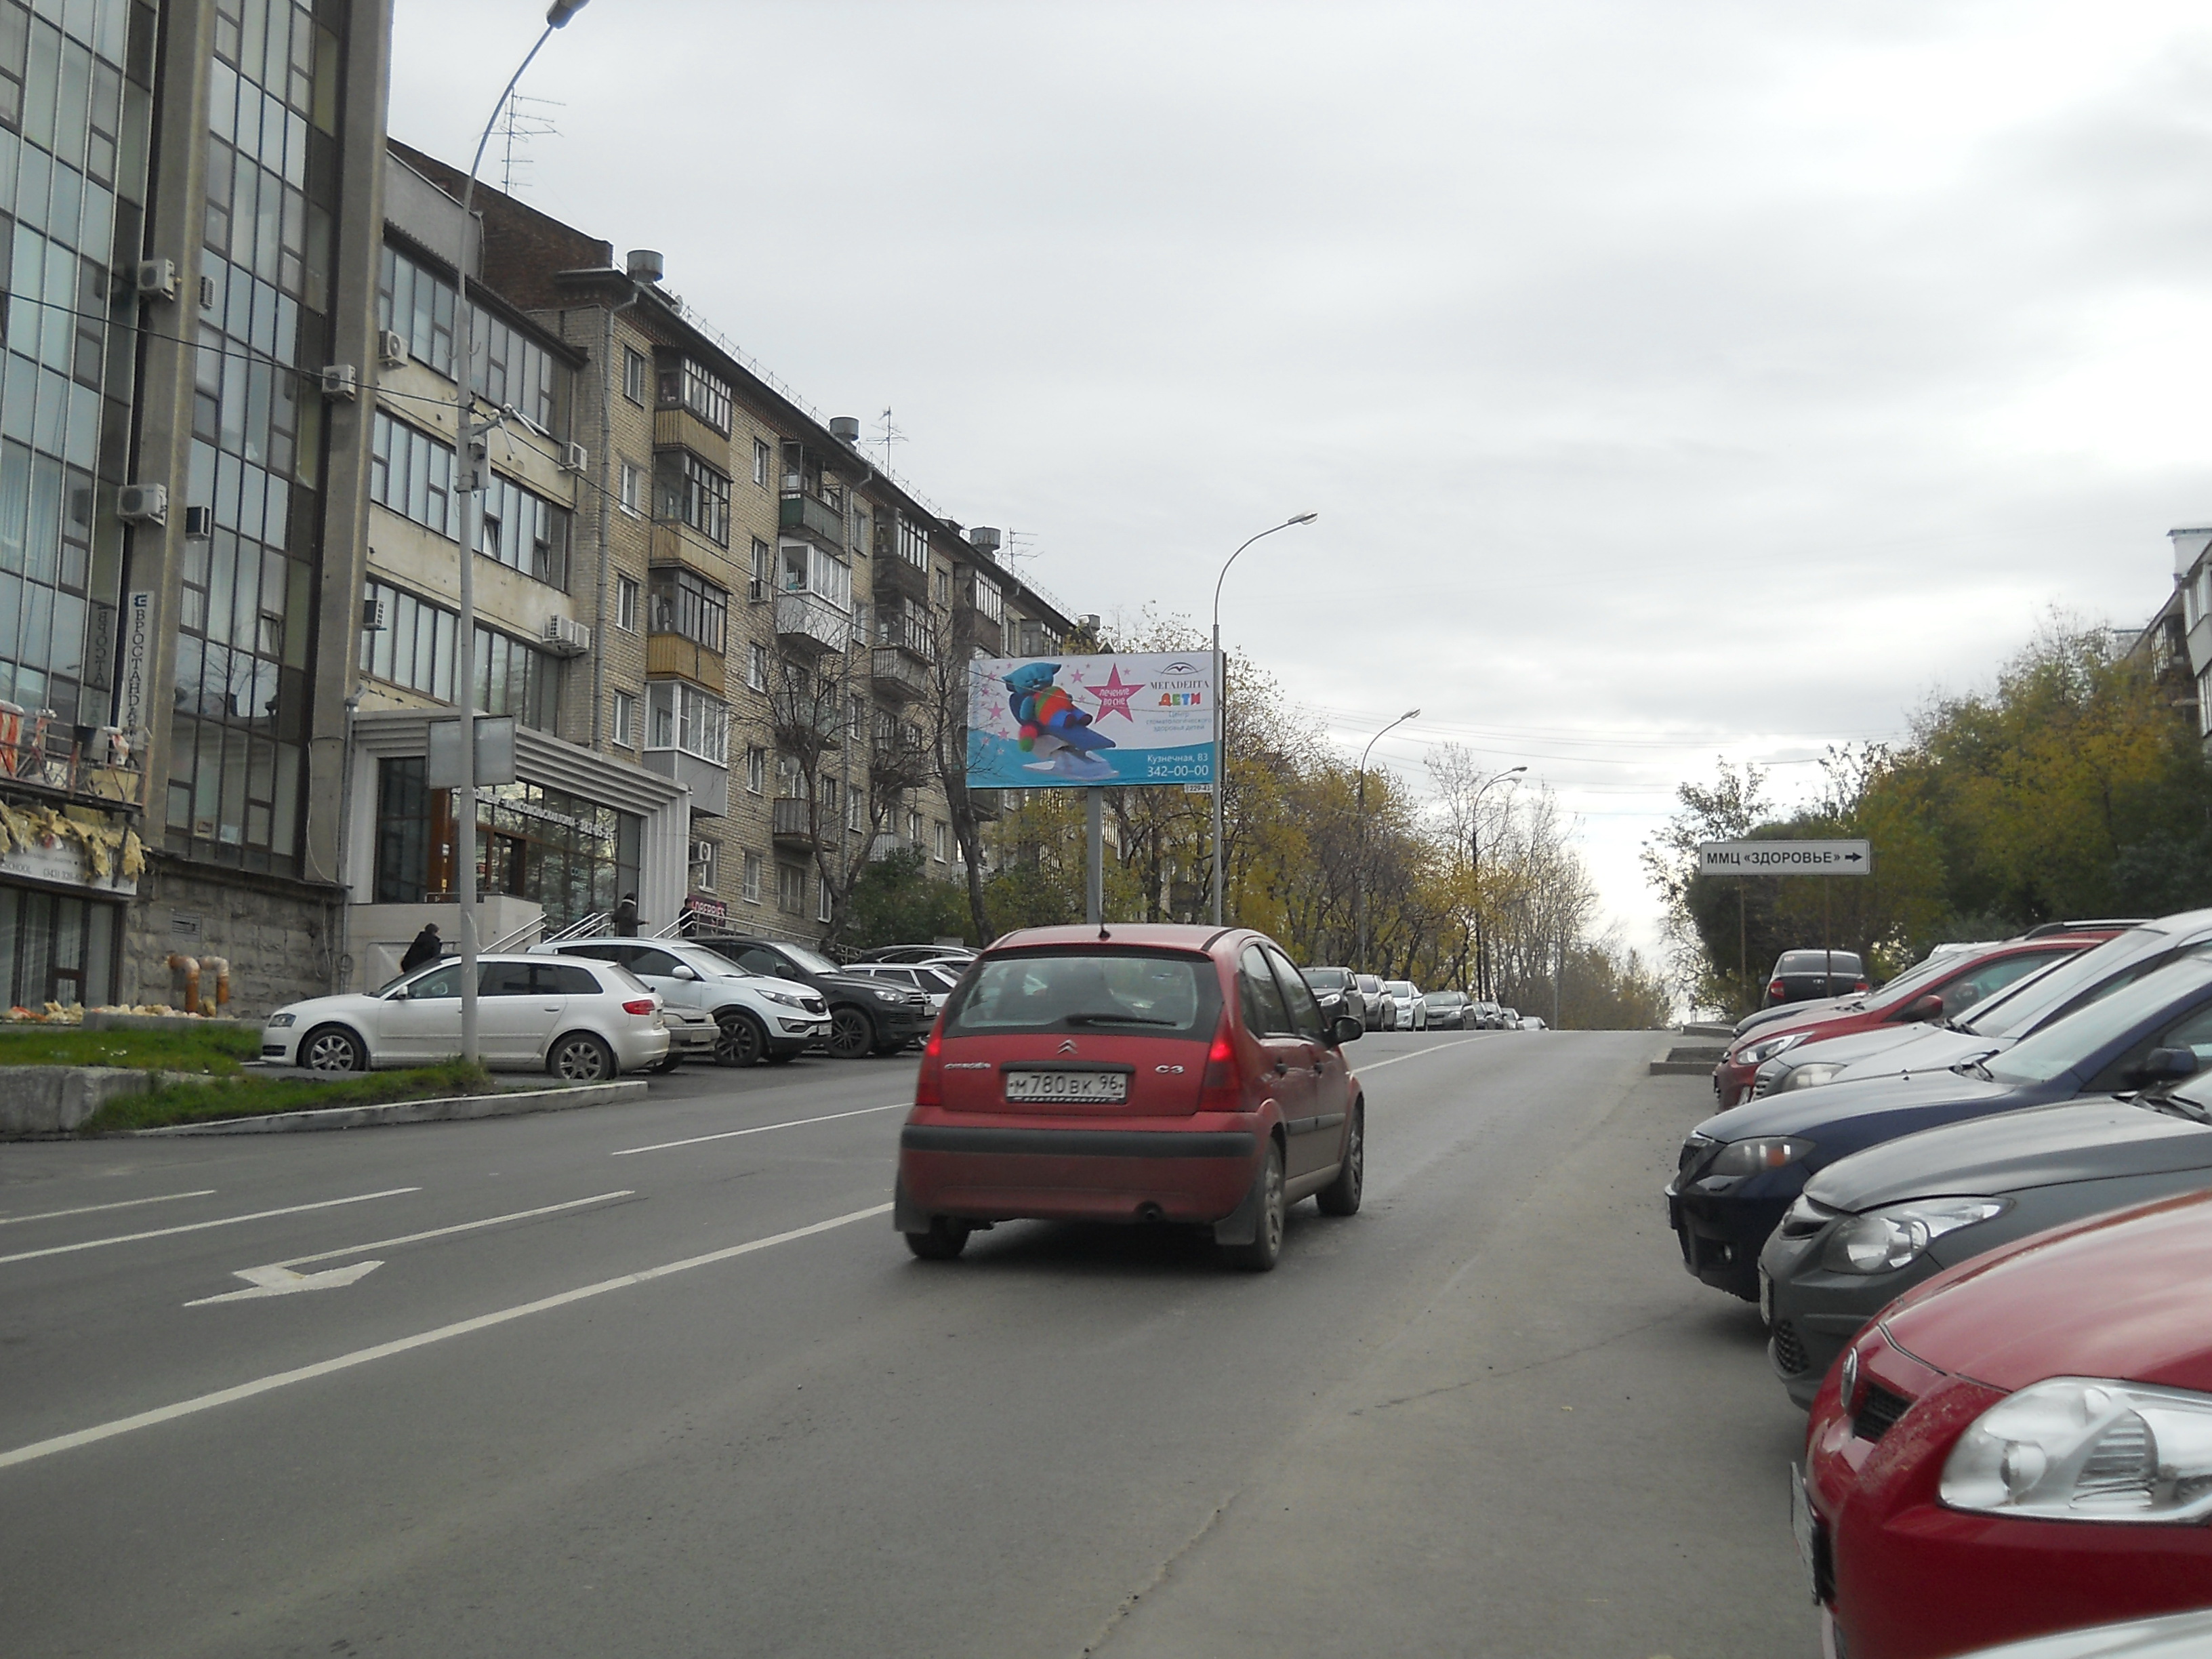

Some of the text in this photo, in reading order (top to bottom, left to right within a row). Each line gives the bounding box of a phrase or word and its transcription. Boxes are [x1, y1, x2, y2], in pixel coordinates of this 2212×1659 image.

[1158, 692, 1201, 707] ДЕТИ
[1147, 753, 1208, 765] Кузнечная, 83
[1706, 851, 1841, 866] ММЦ «ЗДОРОВЬЕ»
[1154, 1064, 1185, 1074] C3
